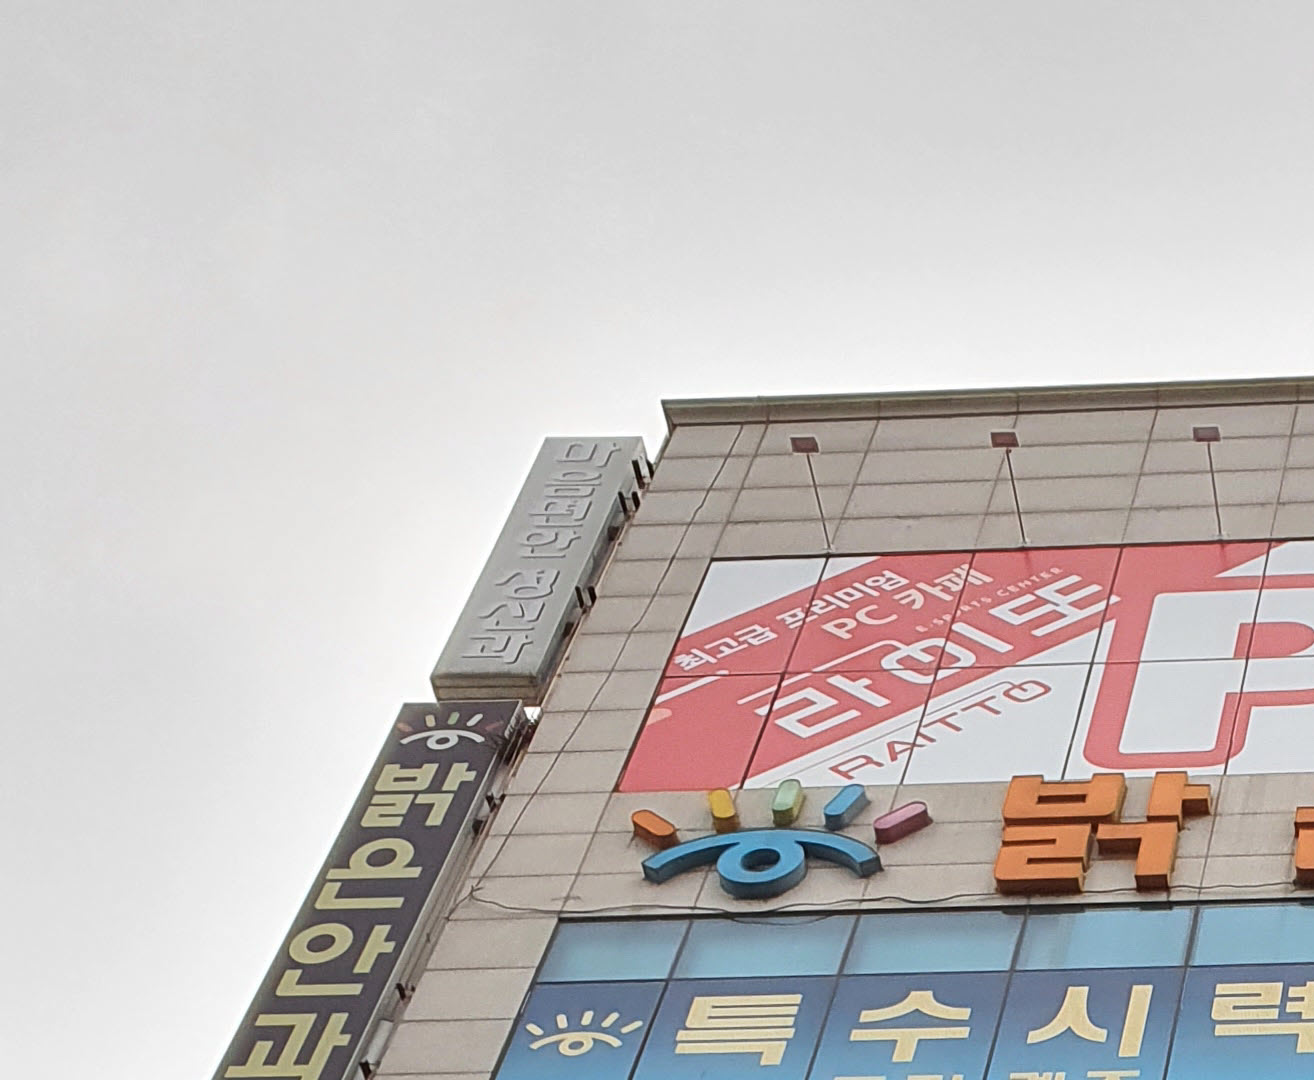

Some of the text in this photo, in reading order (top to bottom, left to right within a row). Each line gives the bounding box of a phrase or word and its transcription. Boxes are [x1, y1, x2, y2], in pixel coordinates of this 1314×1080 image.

[674, 569, 910, 671] 최고급 프리미엄
[821, 563, 994, 640] PC 카페
[755, 575, 1119, 739] 라이또
[828, 679, 1052, 780] RAITTO
